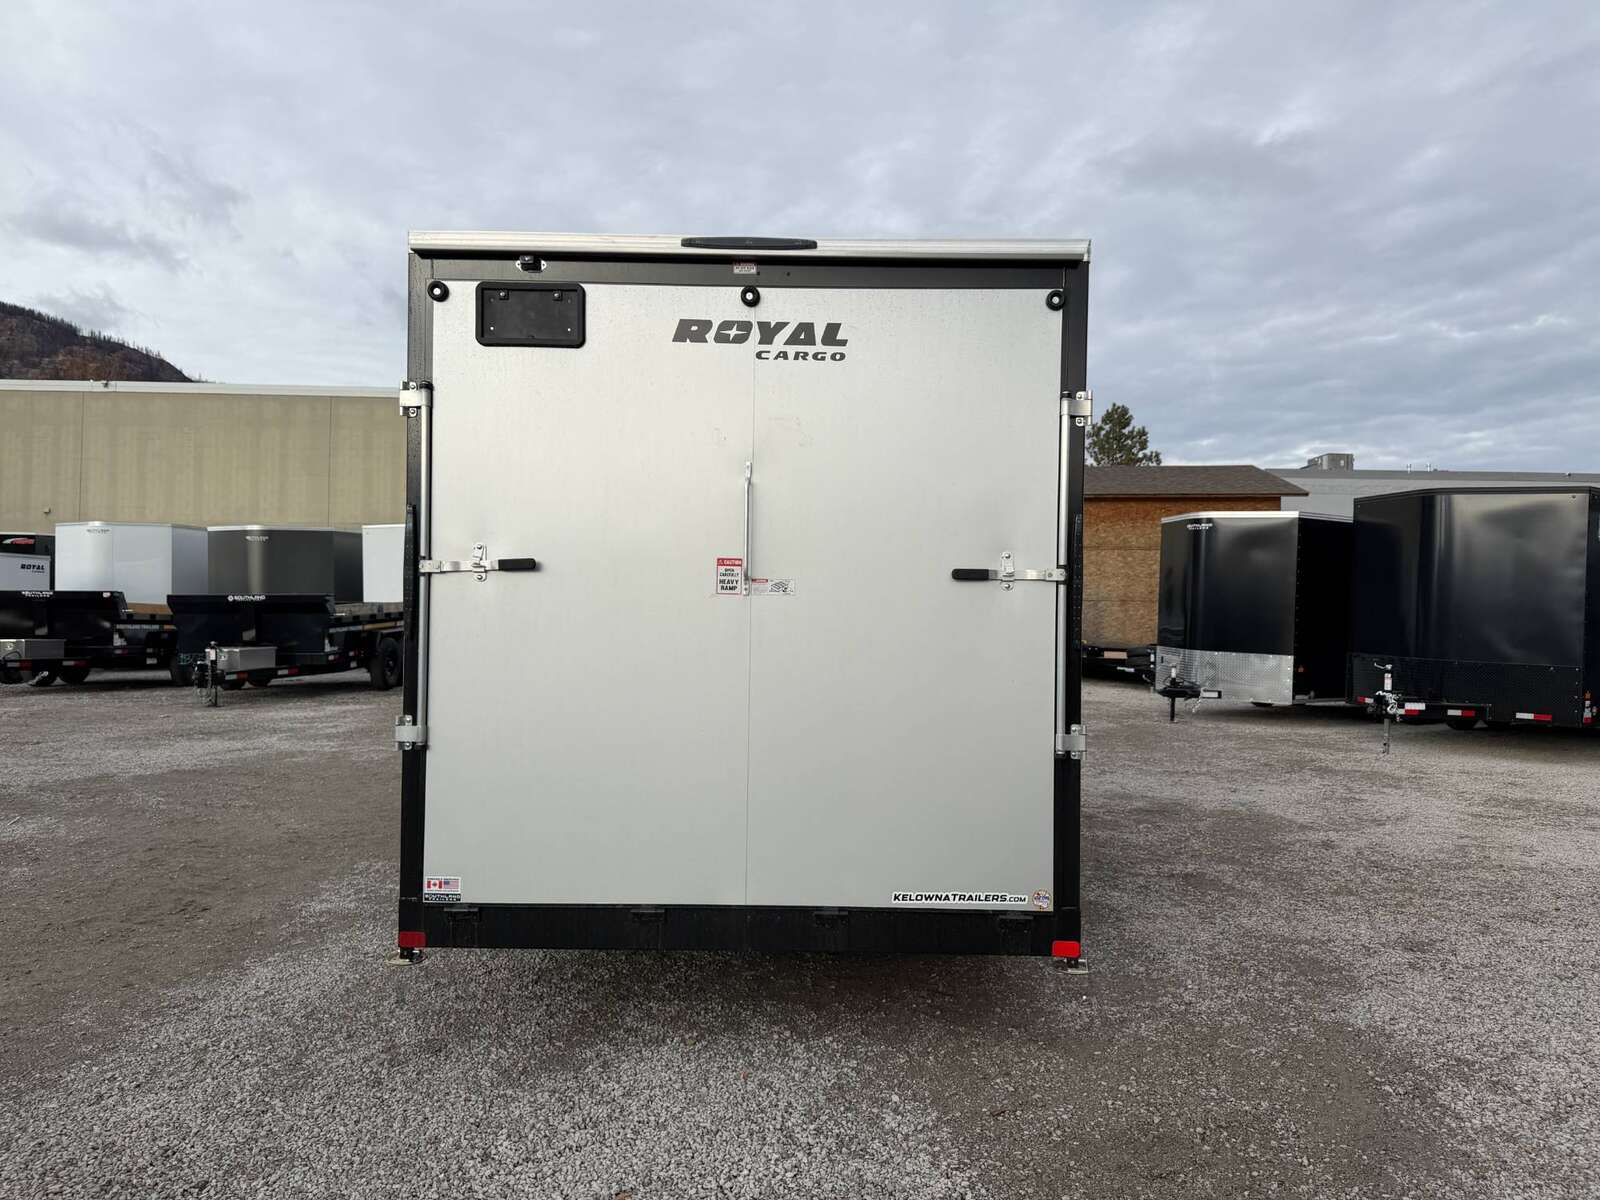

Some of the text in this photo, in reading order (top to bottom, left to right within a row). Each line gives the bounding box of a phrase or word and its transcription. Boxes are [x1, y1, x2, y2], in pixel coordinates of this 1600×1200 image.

[672, 319, 848, 346] ROYAL
[755, 350, 846, 362] CARGO
[20, 563, 45, 571] ROYAL
